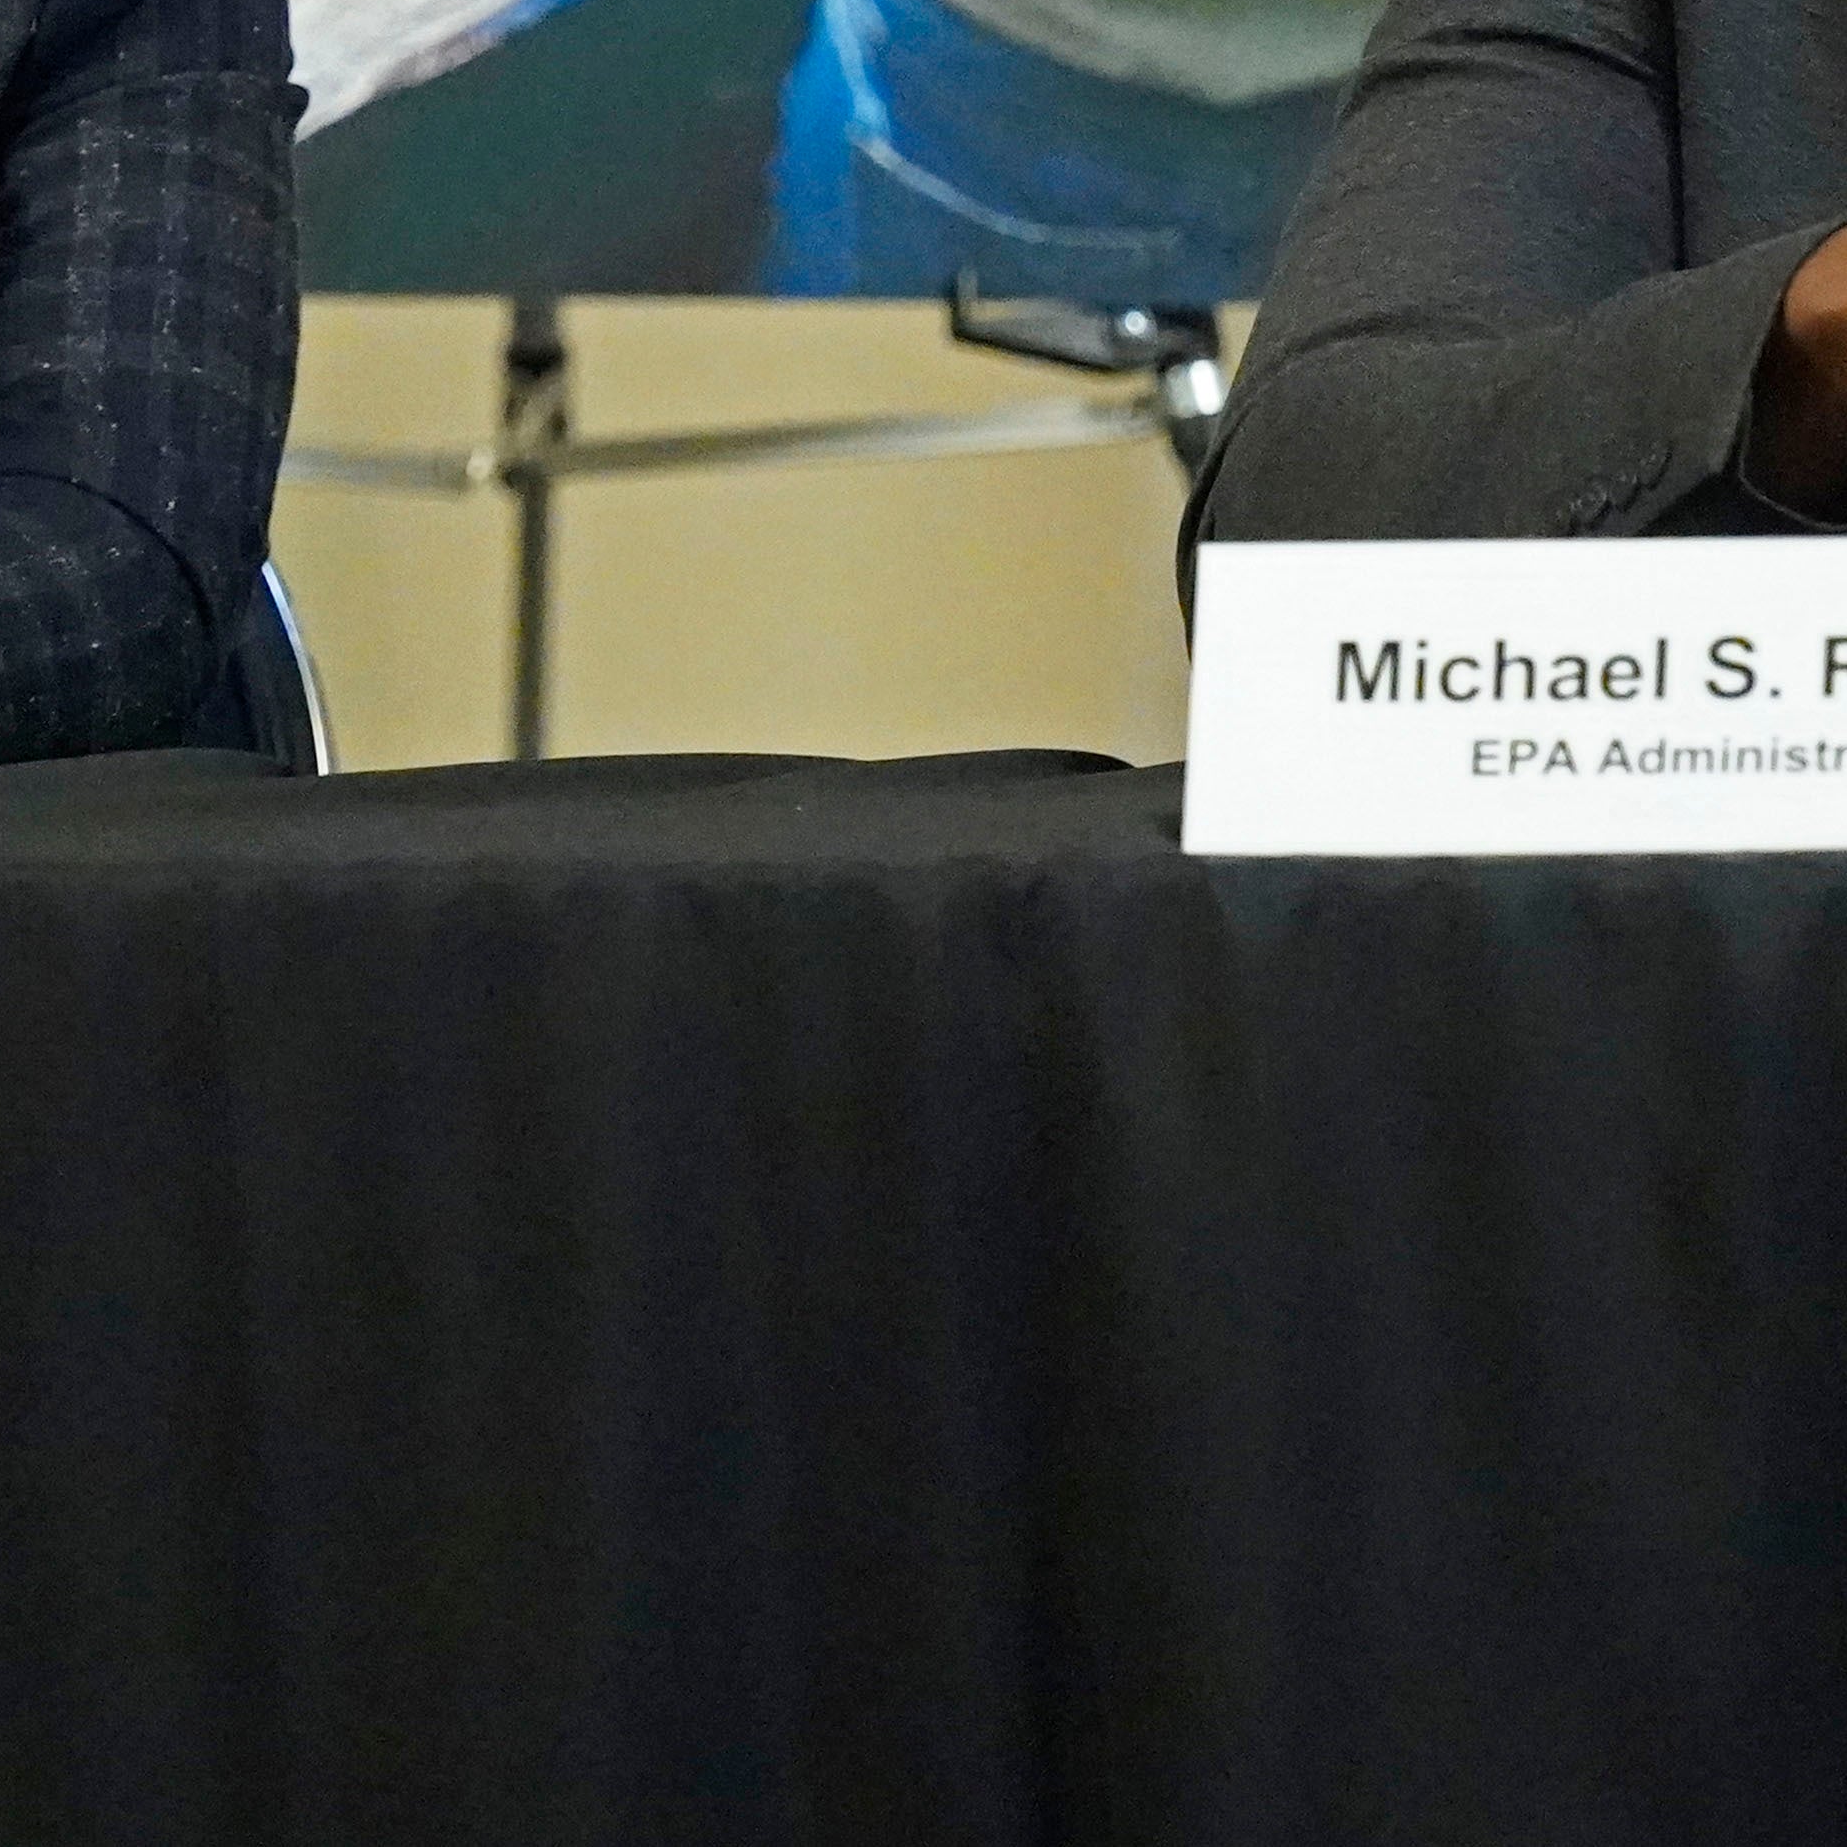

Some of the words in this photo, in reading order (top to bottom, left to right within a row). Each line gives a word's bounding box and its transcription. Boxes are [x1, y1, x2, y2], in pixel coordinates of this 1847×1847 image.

[1335, 638, 1669, 703] Michael
[1704, 636, 1781, 701] S.
[1471, 739, 1579, 777] EPA
